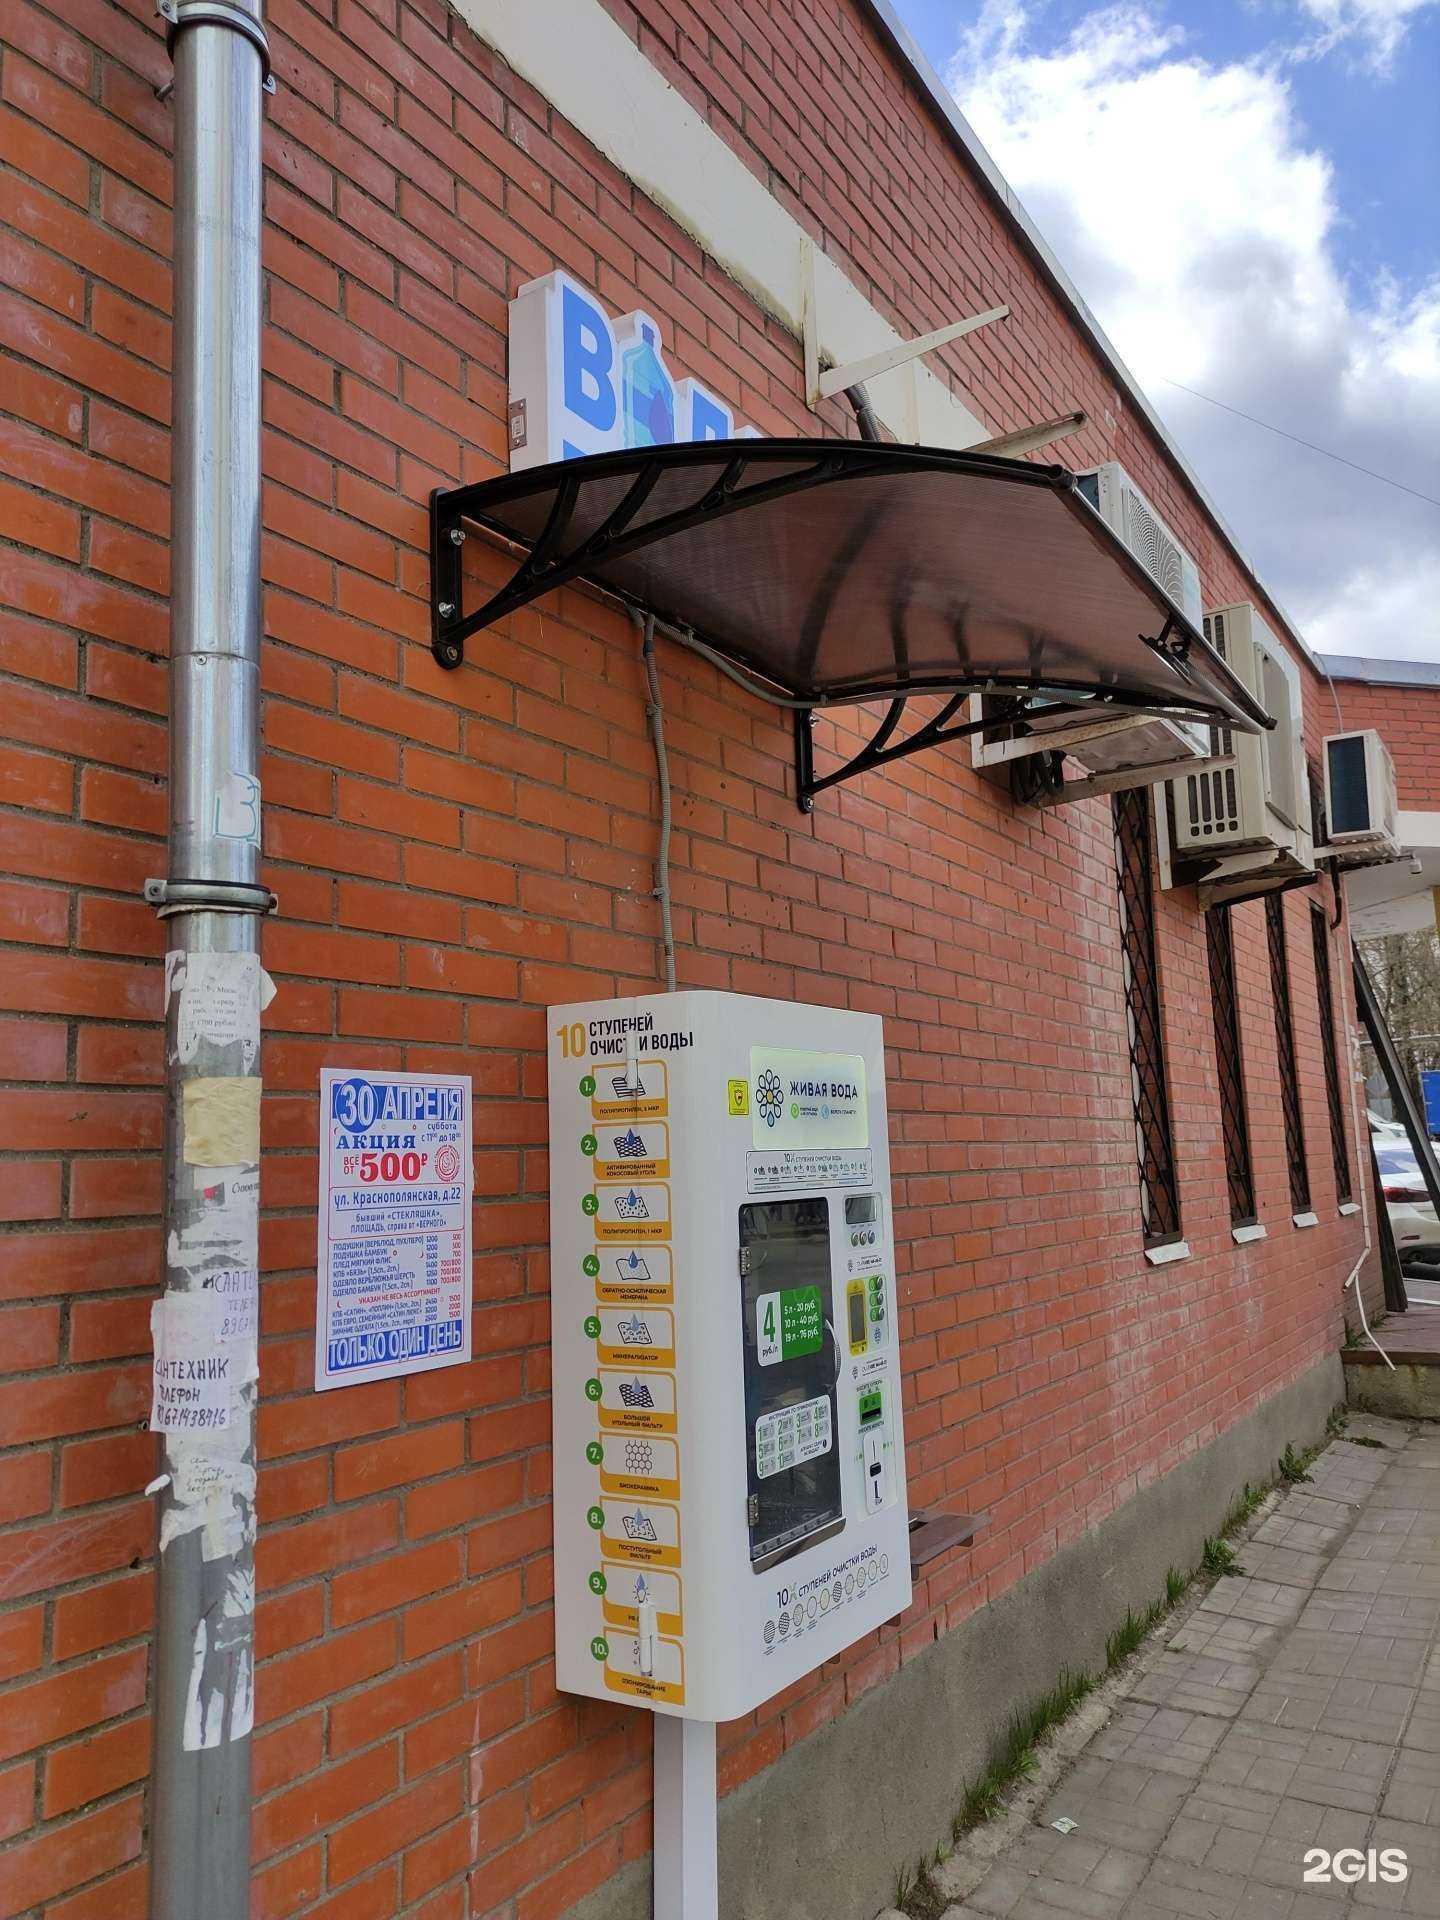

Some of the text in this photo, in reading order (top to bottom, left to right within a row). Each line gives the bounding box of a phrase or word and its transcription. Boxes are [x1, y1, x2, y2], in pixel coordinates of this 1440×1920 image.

[556, 1011, 654, 1058] 10 СТУПЕНЕЙ
[652, 1031, 694, 1052] ВОДЫ
[584, 1080, 592, 1092] 1.
[790, 1080, 858, 1100] ЖИВАЯ ВОДА
[340, 1084, 462, 1126] 30 АПРЕЛЯ
[428, 1122, 457, 1131] суббота
[336, 1135, 416, 1152] АКЦИЯ
[584, 1140, 594, 1150] 2.
[344, 1157, 360, 1166] ВСЕ
[344, 1166, 354, 1174] ОТ
[334, 1194, 350, 1210] ул.
[586, 1200, 596, 1210] 3.
[356, 1213, 384, 1222] бывший
[333, 1250, 363, 1260] ПОДУШКА
[364, 1248, 388, 1258] БАМБУК
[333, 1260, 350, 1269] ПЛЕД
[586, 1260, 596, 1271] 4.
[394, 1272, 416, 1280] ШЕРСТЬ
[358, 1296, 380, 1304] УКАЗАН
[797, 1302, 804, 1312] 20
[764, 1302, 776, 1342] 4
[785, 1319, 791, 1328] 10
[800, 1315, 807, 1324] 40
[588, 1323, 598, 1333] 5.
[330, 1321, 462, 1368] ТОЛЬКО ОДИН ДЕНЬ
[588, 1384, 599, 1396] 6.
[590, 1448, 600, 1459] 7.
[619, 1482, 660, 1492] БИОКЕРАМИКА
[590, 1512, 602, 1523] 8.
[777, 1544, 878, 1608] 10 СТУПЕНЕЙ ОЧИСТКИ ВОДЫ
[592, 1578, 603, 1590] 9.
[592, 1642, 608, 1656] 10.
